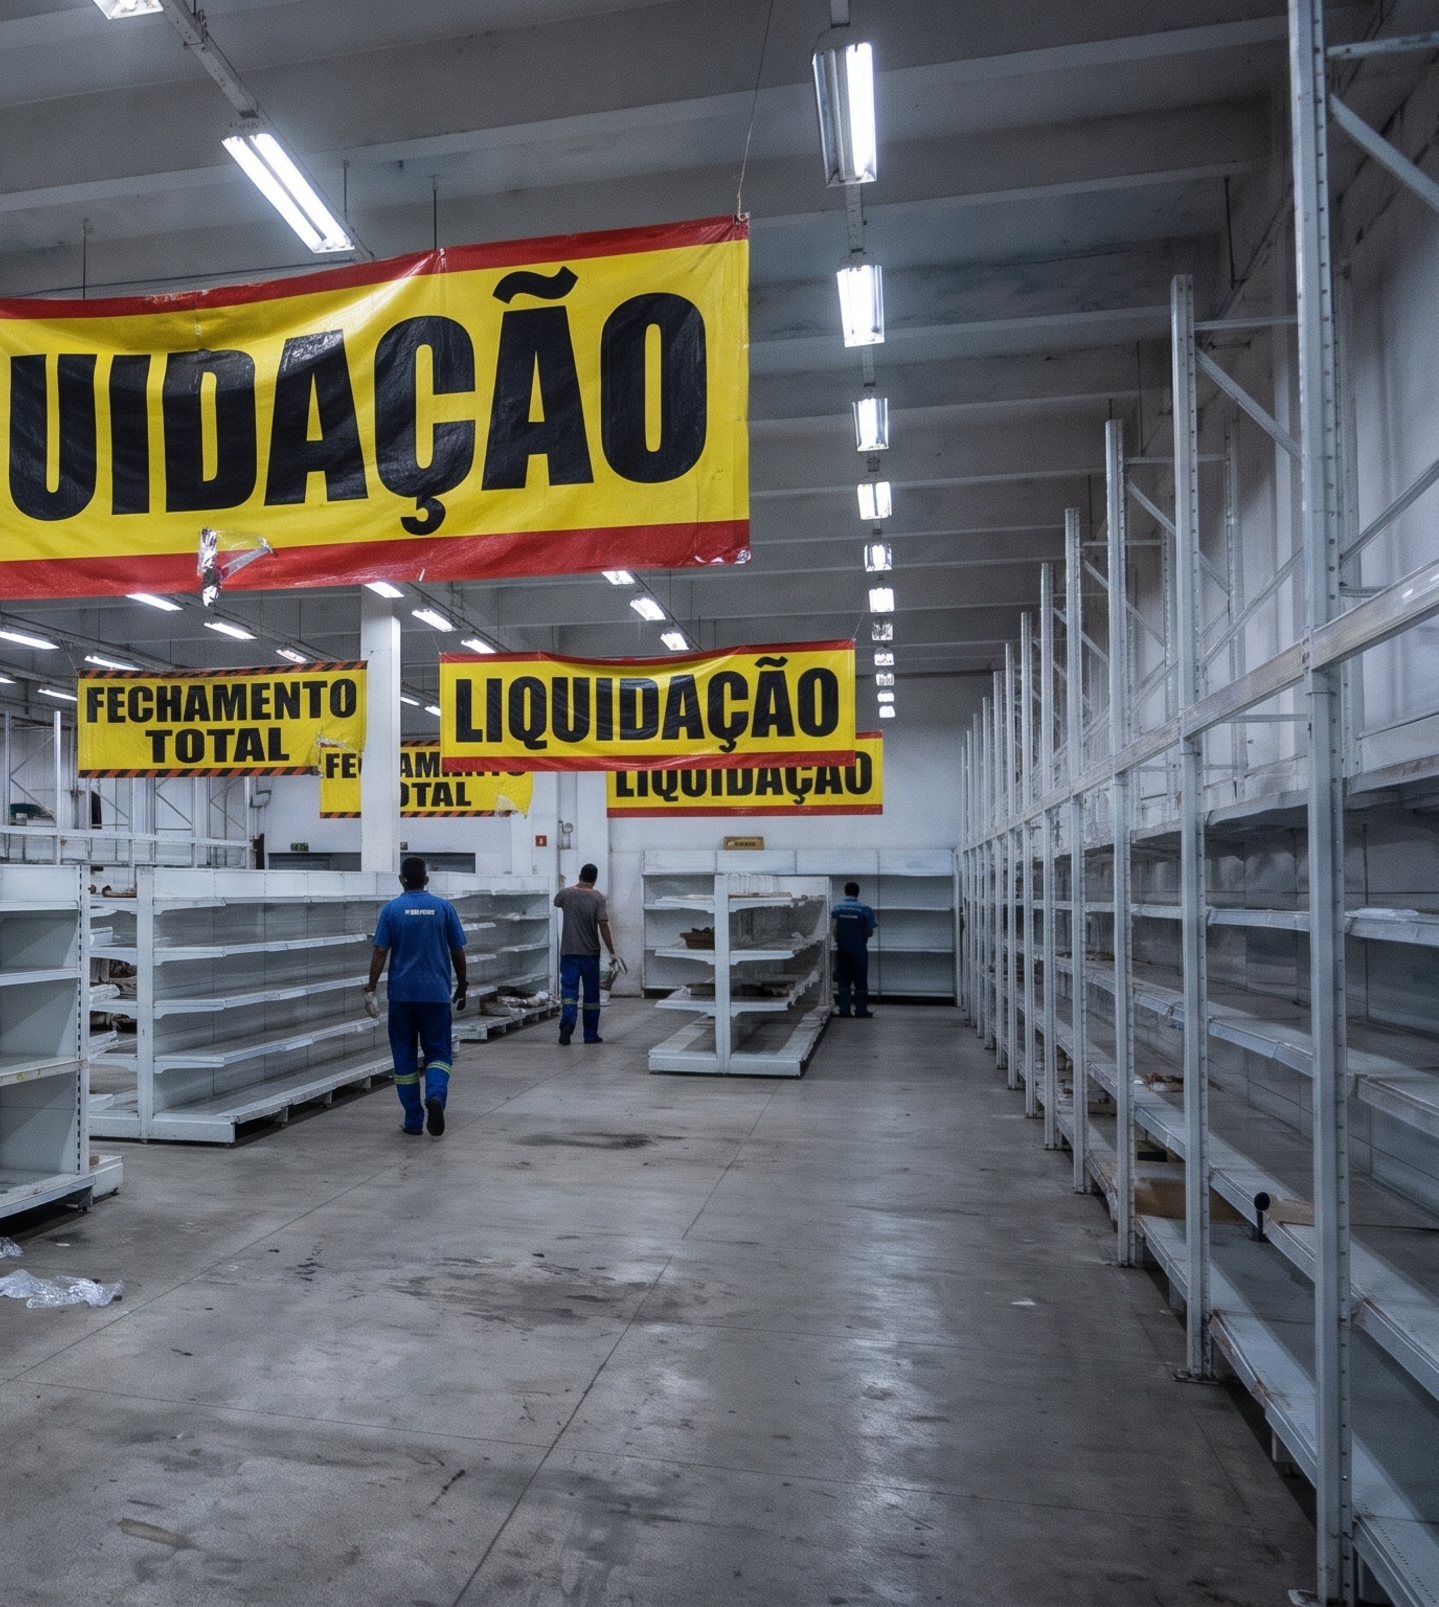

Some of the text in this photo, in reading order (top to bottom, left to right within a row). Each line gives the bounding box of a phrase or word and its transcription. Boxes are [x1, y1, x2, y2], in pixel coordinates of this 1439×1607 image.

[86, 679, 357, 724] FECHAMENTO
[455, 655, 839, 753] LIQUIDAÇÃO
[145, 727, 290, 764] TOTAL
[399, 781, 472, 808] TAL
